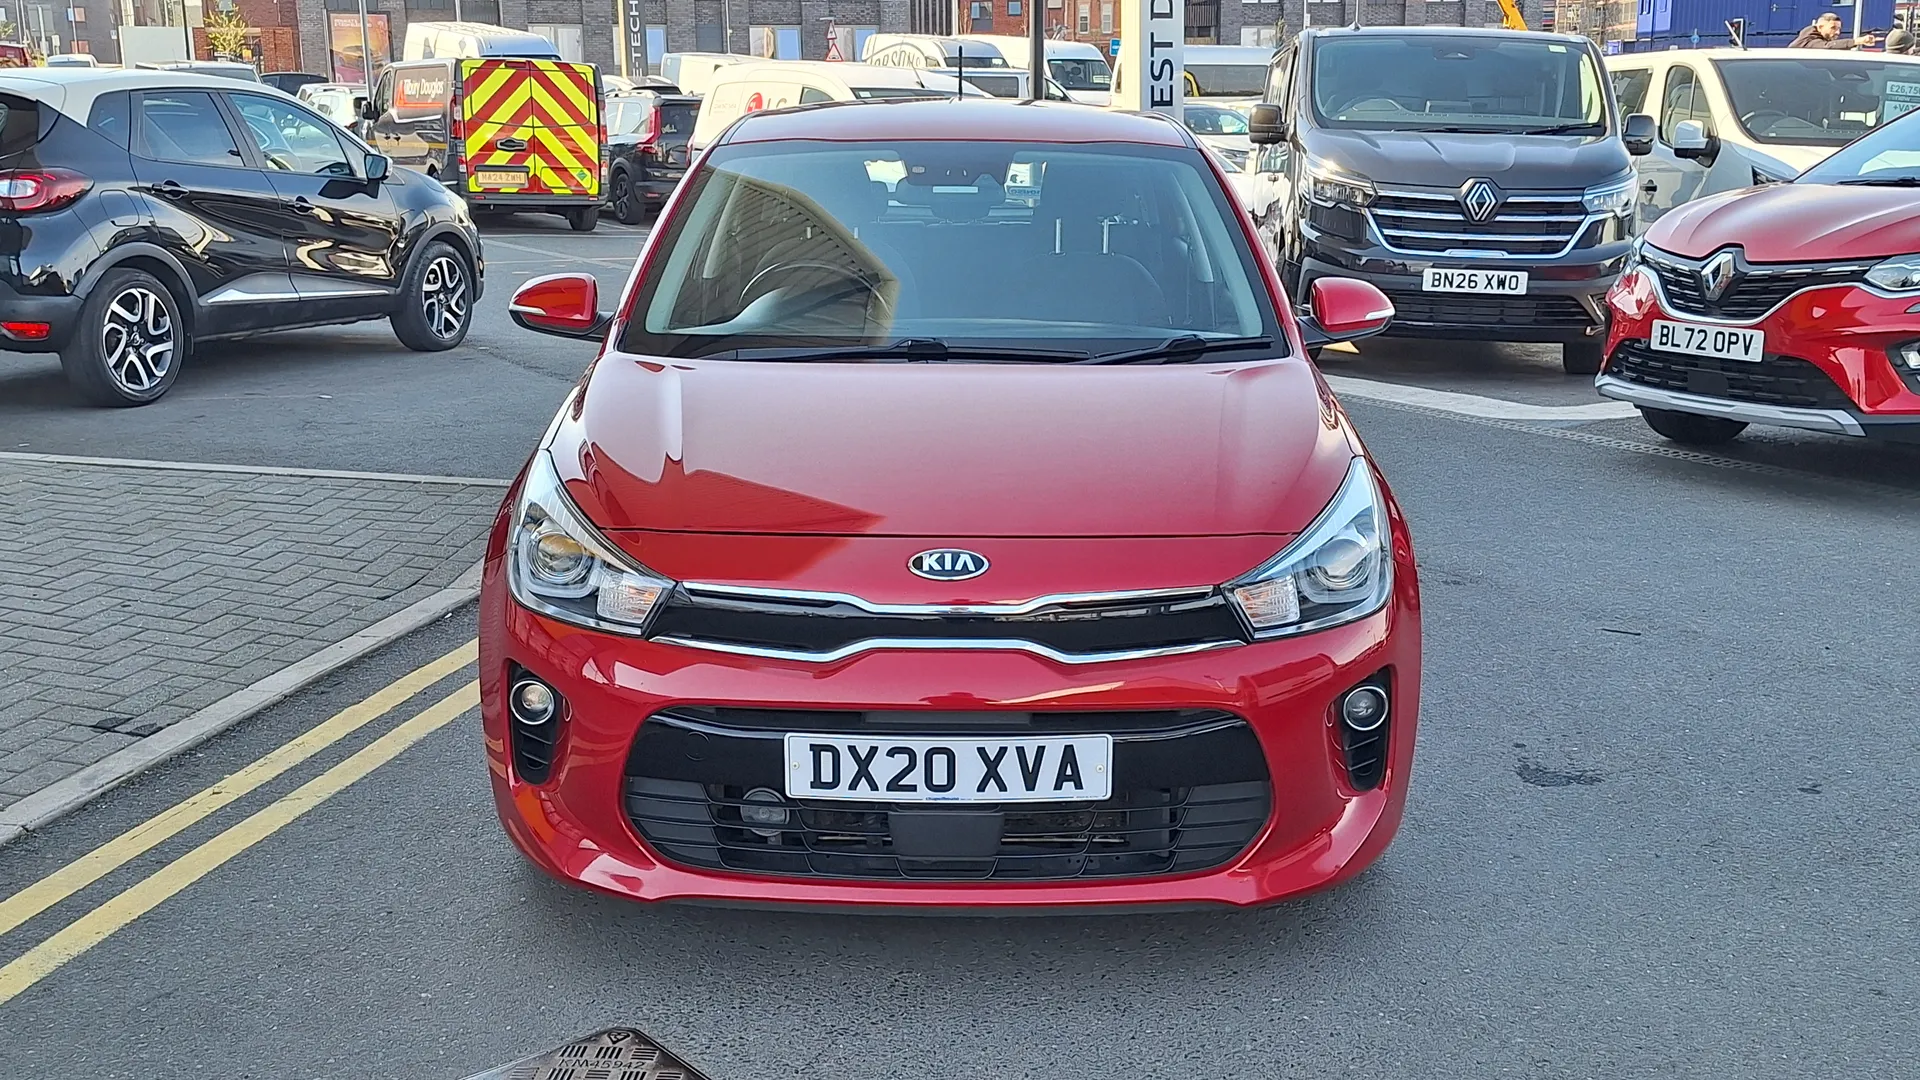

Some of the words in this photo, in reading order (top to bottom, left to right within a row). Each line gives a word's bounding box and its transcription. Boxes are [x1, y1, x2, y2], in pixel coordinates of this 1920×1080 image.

[628, 0, 643, 78] E-TECH
[1150, 31, 1173, 109] EST
[1431, 272, 1478, 289] BN26
[1484, 274, 1519, 291] XWO
[1659, 325, 1708, 351] BL72
[1713, 331, 1754, 356] OPV
[921, 553, 976, 571] KIA
[809, 743, 956, 793] DX20
[976, 744, 1084, 793] XVA
[558, 1059, 646, 1069] KM45942
